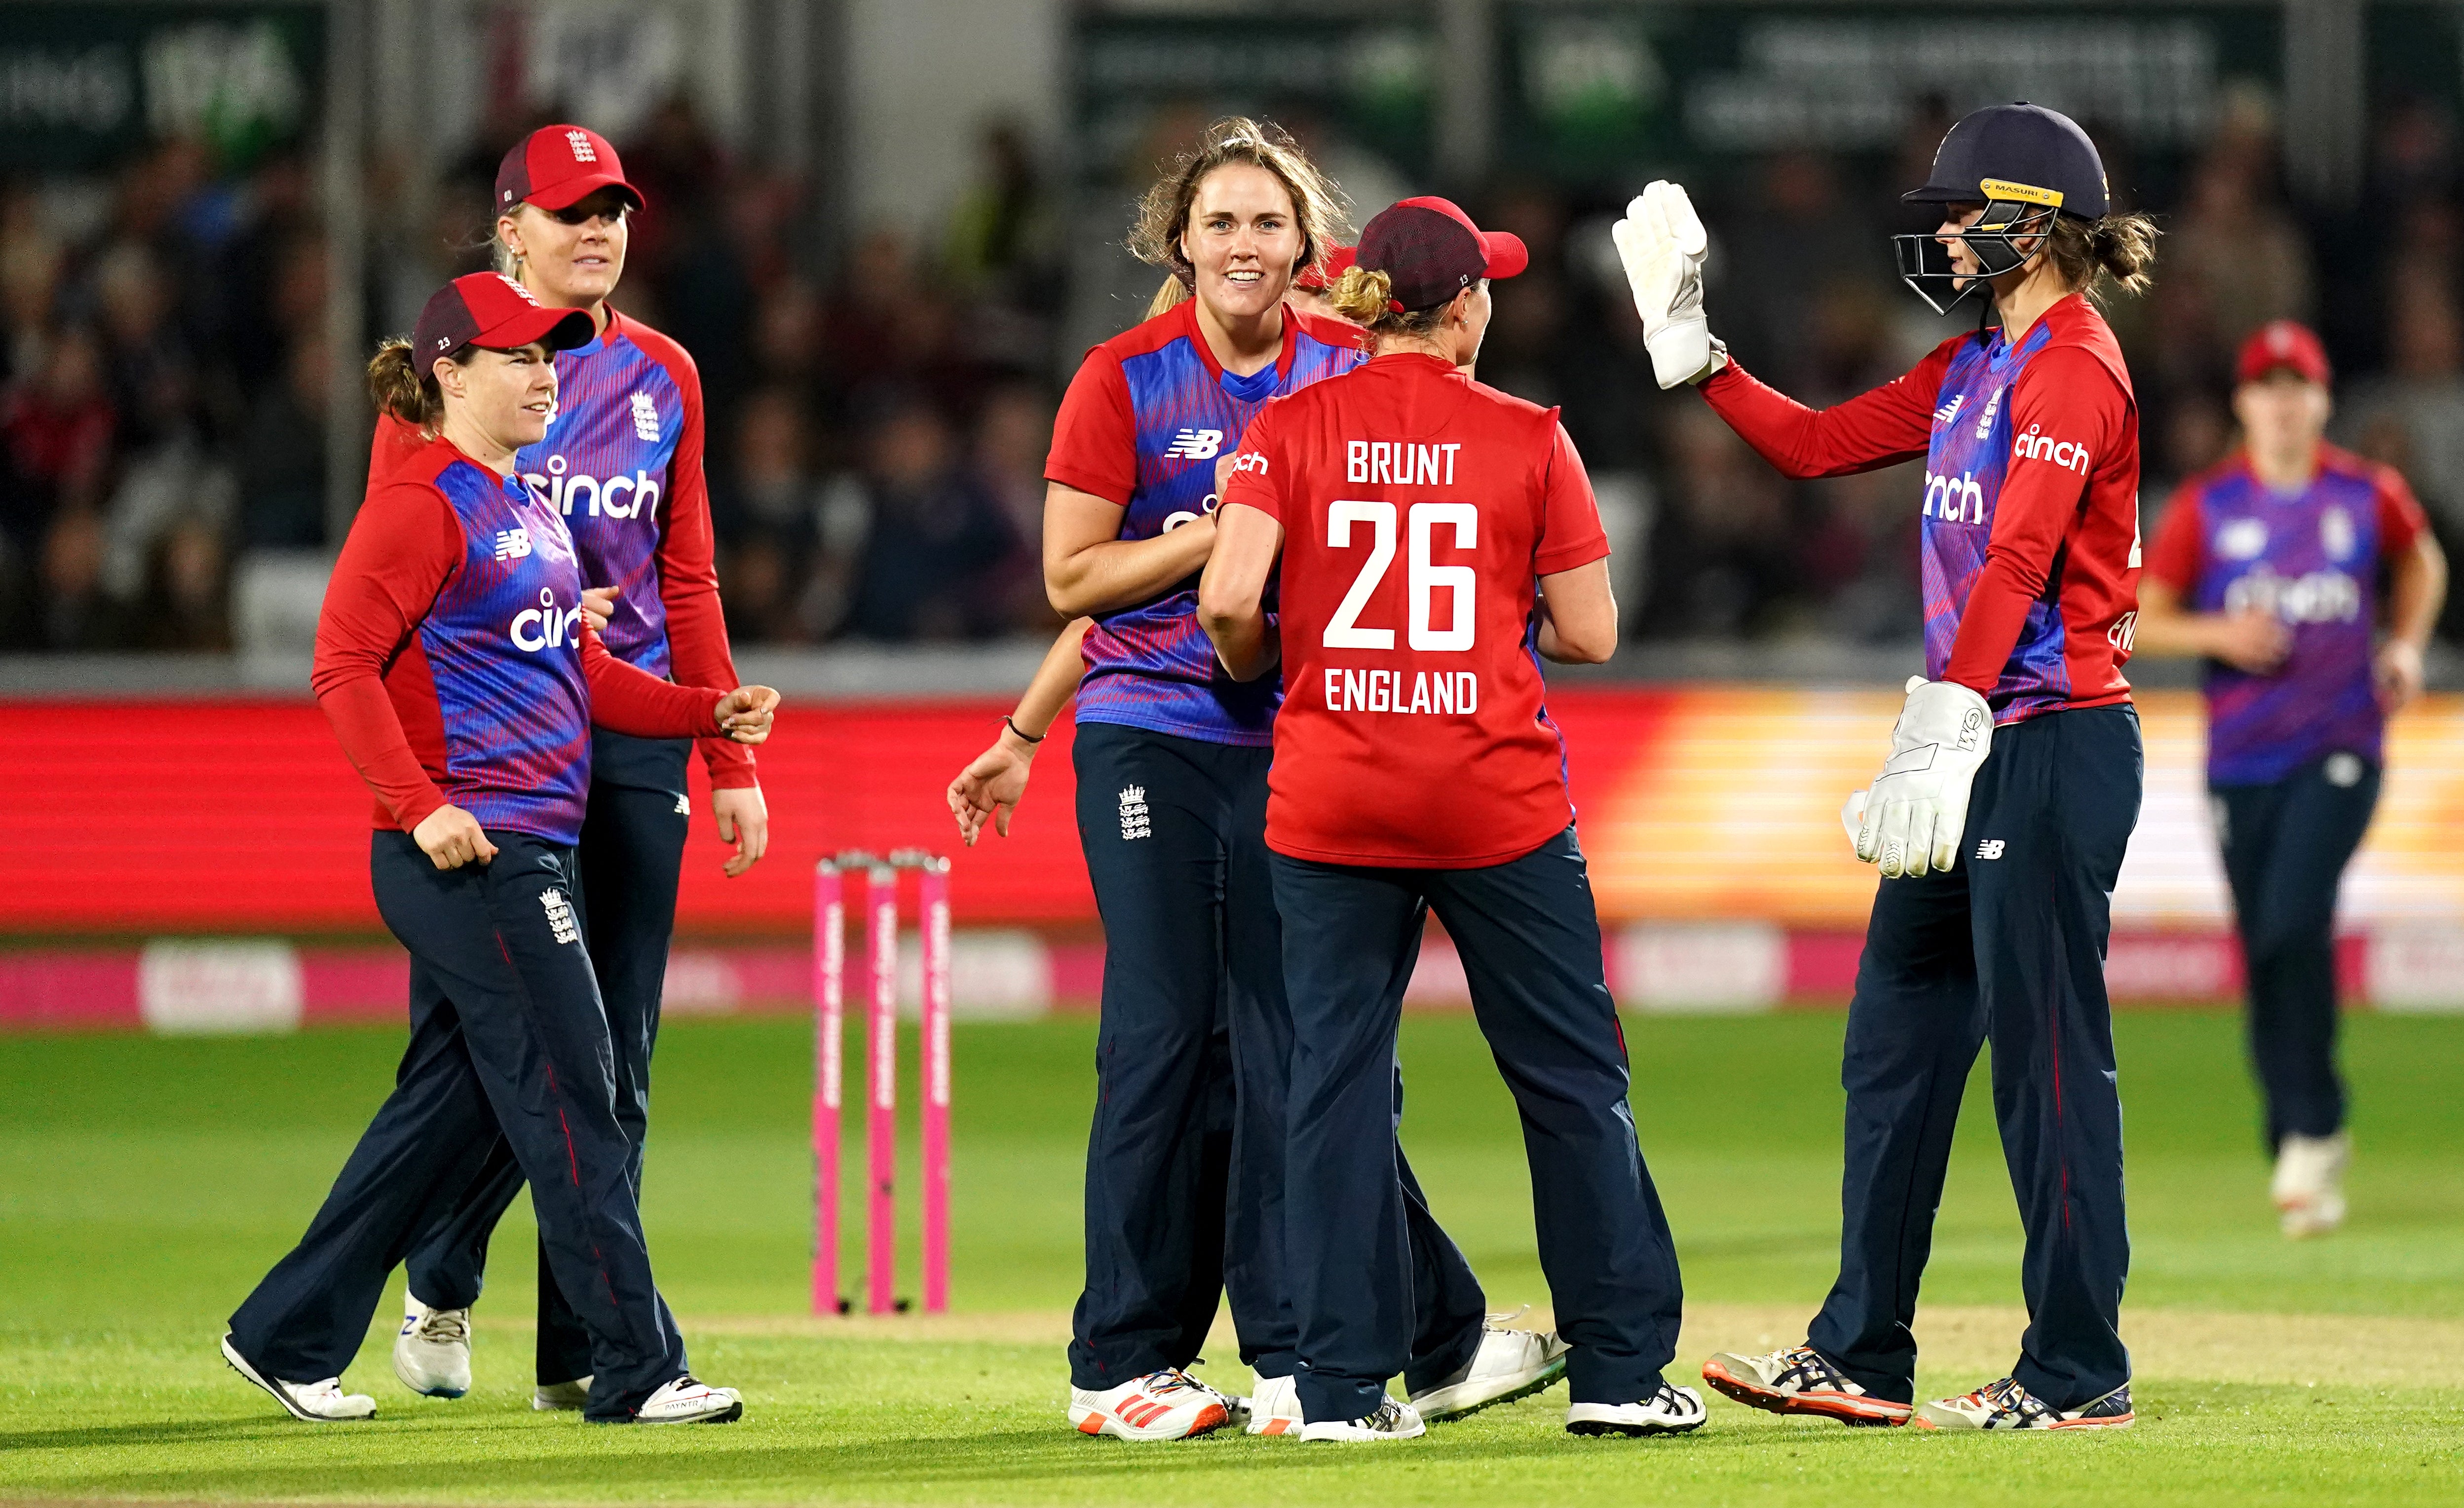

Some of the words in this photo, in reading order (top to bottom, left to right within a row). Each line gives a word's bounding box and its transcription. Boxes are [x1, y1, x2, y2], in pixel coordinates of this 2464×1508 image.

[1996, 185, 2038, 196] MASURI
[1459, 274, 1468, 286] 13
[438, 337, 450, 350] 23
[1348, 441, 1461, 485] BRUNT
[2015, 423, 2089, 476] cinch
[1323, 500, 1478, 651] 26
[1325, 668, 1478, 715] ENGLAND
[1957, 708, 1983, 752] GM
[665, 1400, 698, 1411] PAYNTR
